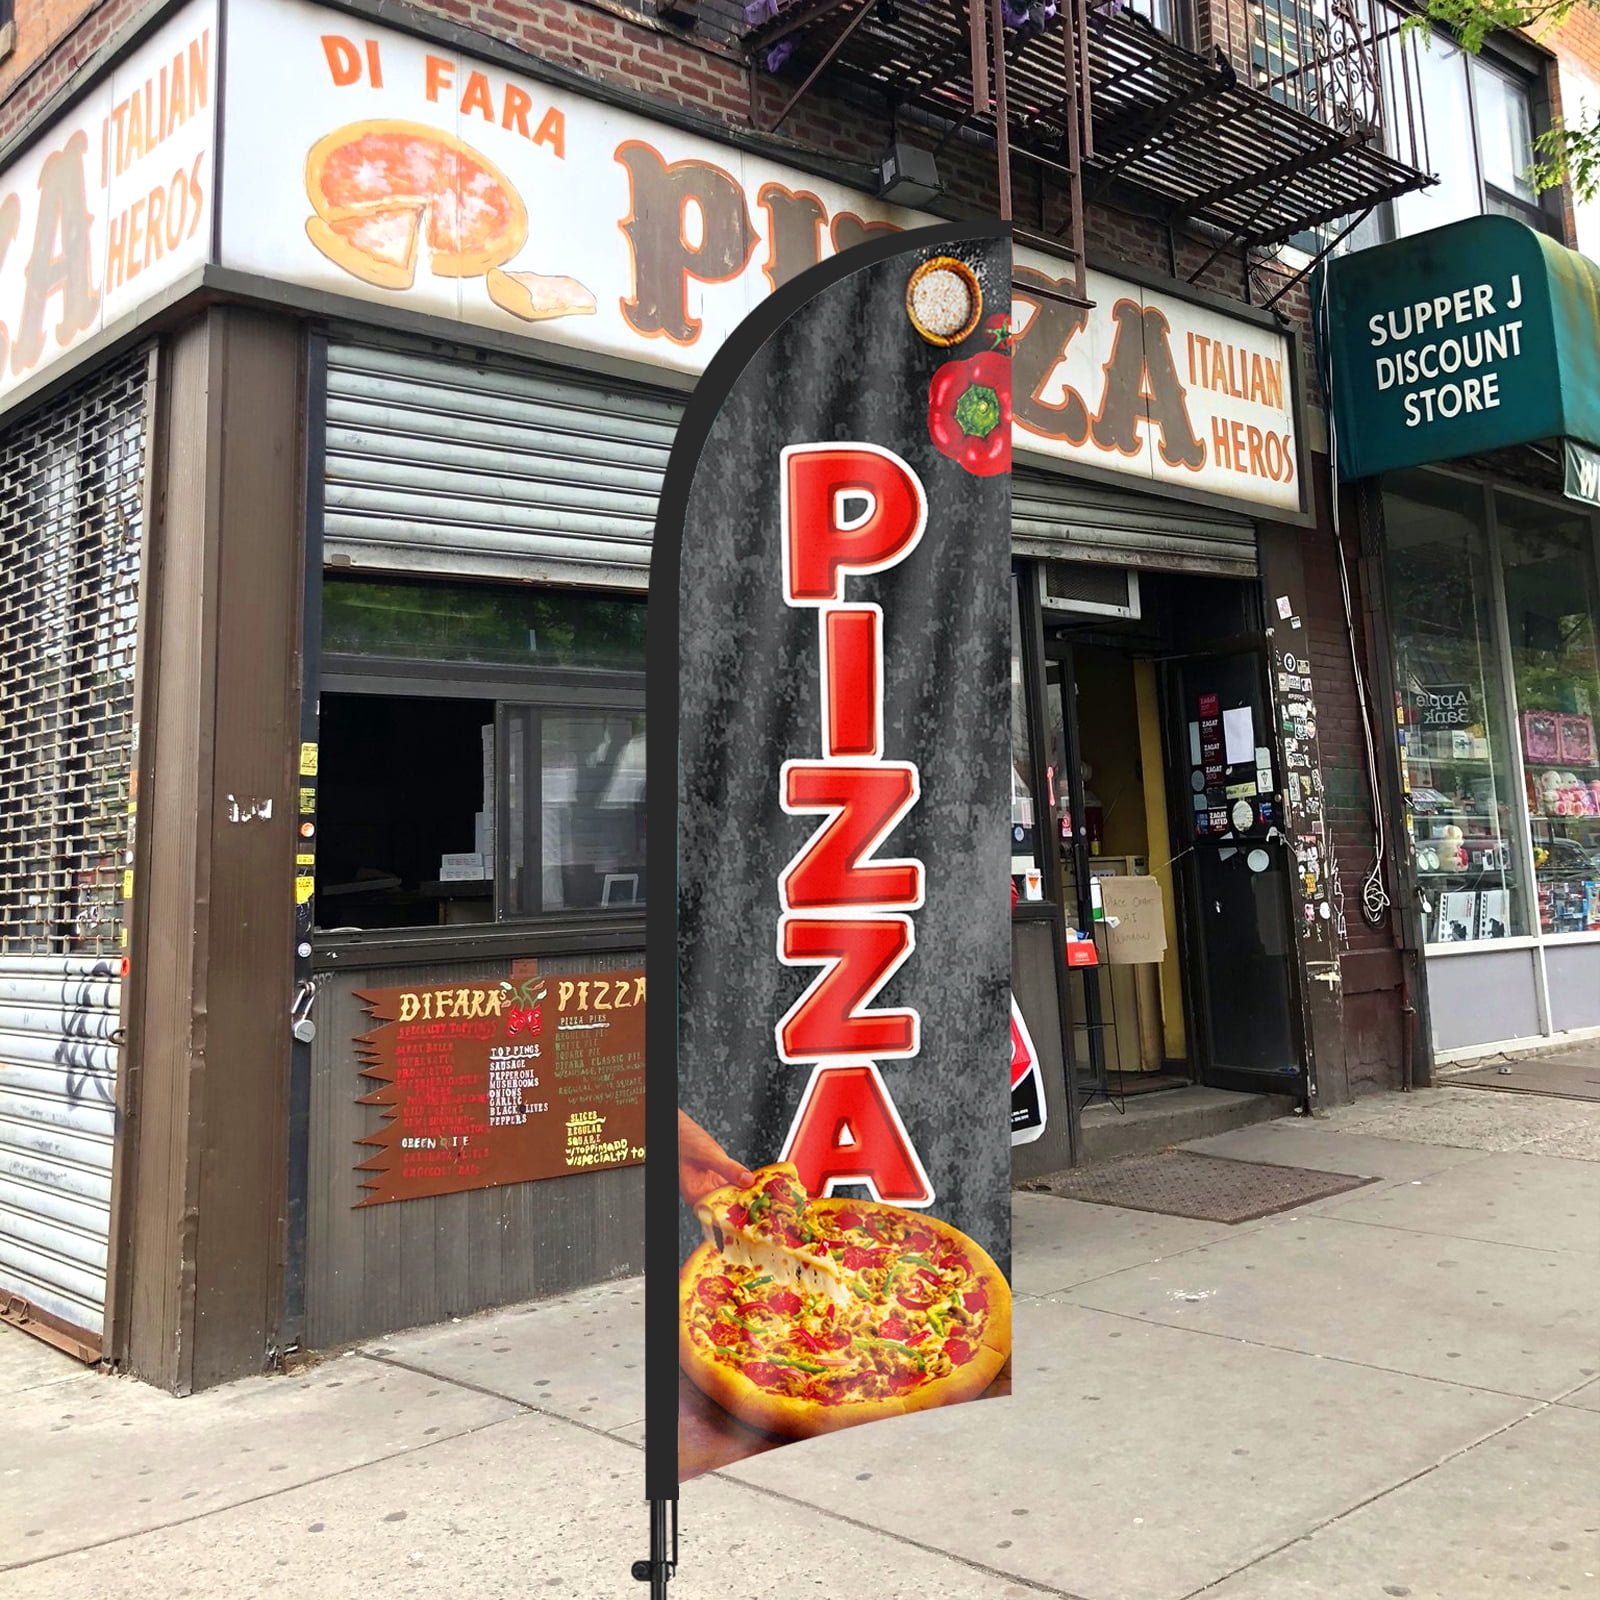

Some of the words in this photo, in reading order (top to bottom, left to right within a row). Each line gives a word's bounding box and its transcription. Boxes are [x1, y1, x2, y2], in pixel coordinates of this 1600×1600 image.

[320, 35, 384, 89] DI
[426, 54, 566, 161] FARA
[102, 28, 209, 188] ITALIAN
[106, 150, 204, 295] HEROS
[1369, 284, 1497, 346] SUPPER
[1507, 274, 1523, 309] J
[1376, 320, 1523, 391] DISCOUNT
[1187, 331, 1283, 410] ITALIAN
[1404, 372, 1500, 427] STORE
[1211, 415, 1294, 484] HEROS
[775, 441, 936, 1209] PIZZA
[489, 1060, 526, 1072] SAUSAGE
[489, 1069, 535, 1081] PEPPERONI
[489, 1077, 540, 1090] MUSHROOMS
[489, 1087, 522, 1099] ONIONS
[489, 1096, 523, 1107] GARLIC
[490, 1105, 518, 1116] BLACK
[570, 1110, 598, 1122] SLICES
[490, 1113, 527, 1126] PEPPERS
[567, 1123, 602, 1137] REGULAR
[567, 1134, 601, 1147] SQUARE
